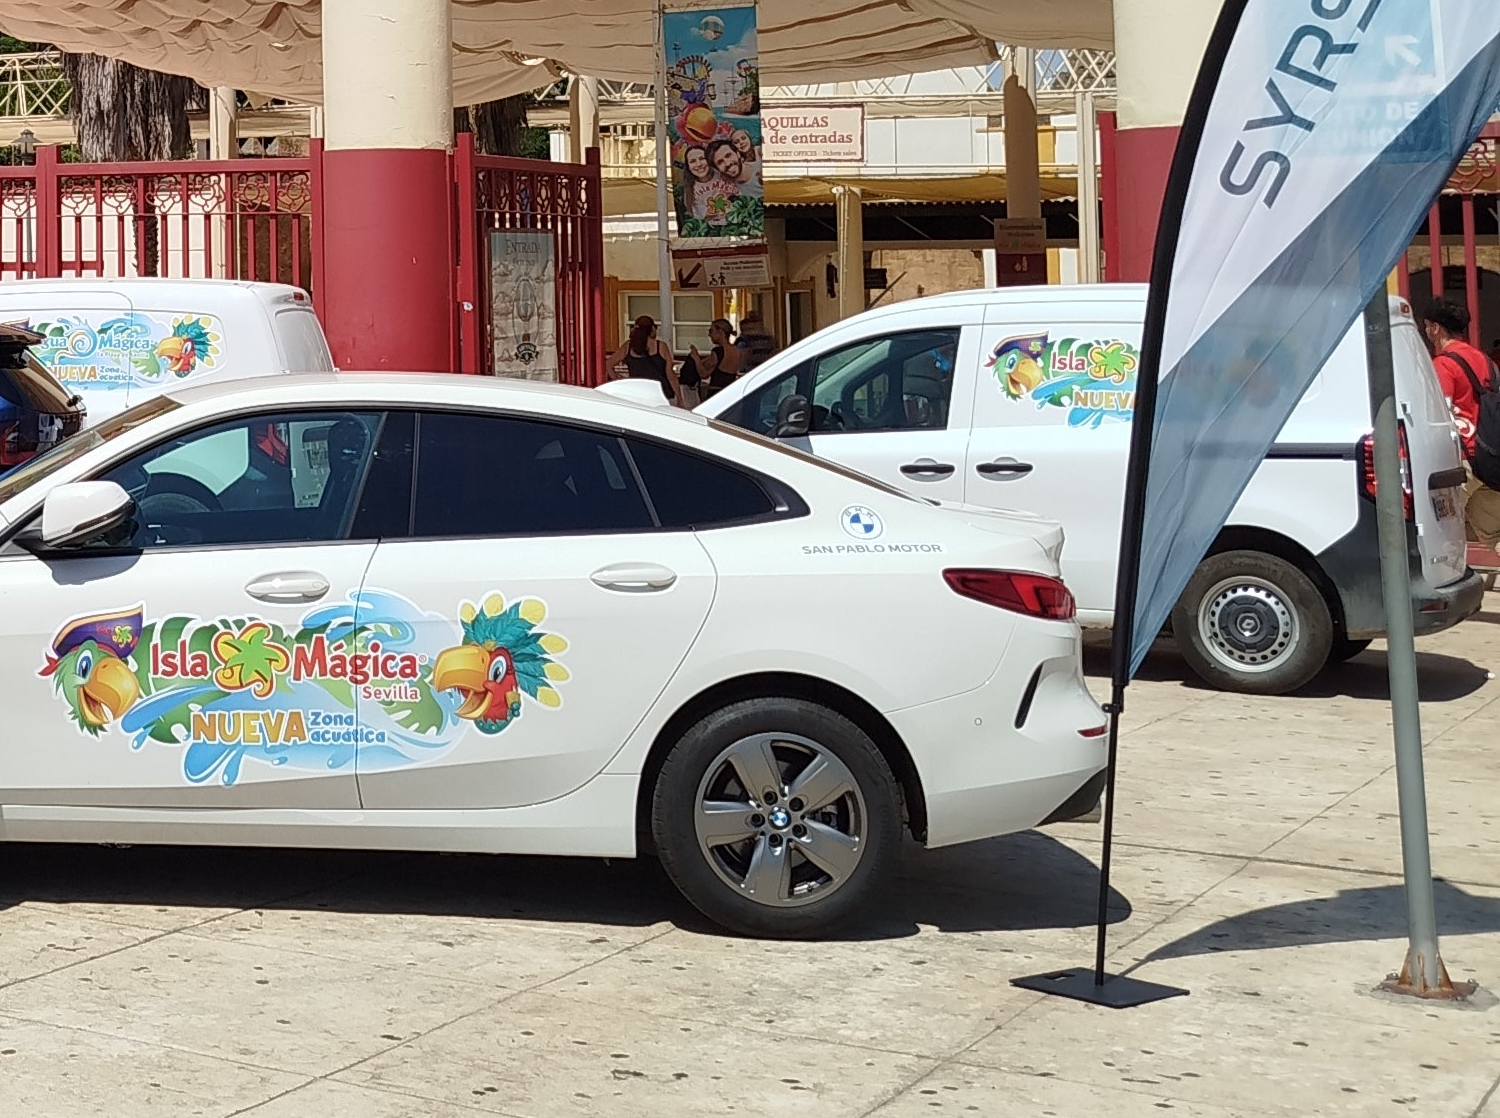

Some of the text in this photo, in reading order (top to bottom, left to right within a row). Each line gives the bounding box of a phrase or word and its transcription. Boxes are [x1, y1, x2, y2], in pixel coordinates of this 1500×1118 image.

[760, 115, 829, 131] AQUILLAS
[769, 129, 788, 145] de
[791, 130, 854, 145] entradas
[40, 334, 150, 352] gua Mágica
[1051, 350, 1086, 371] Isla
[100, 365, 120, 373] Zona
[802, 543, 943, 555] SAN PABLO MOTOR
[151, 639, 209, 678] Isla
[362, 685, 419, 701] Sevilla
[192, 710, 354, 744] NUEVA Zona
[310, 727, 386, 744] acuática
